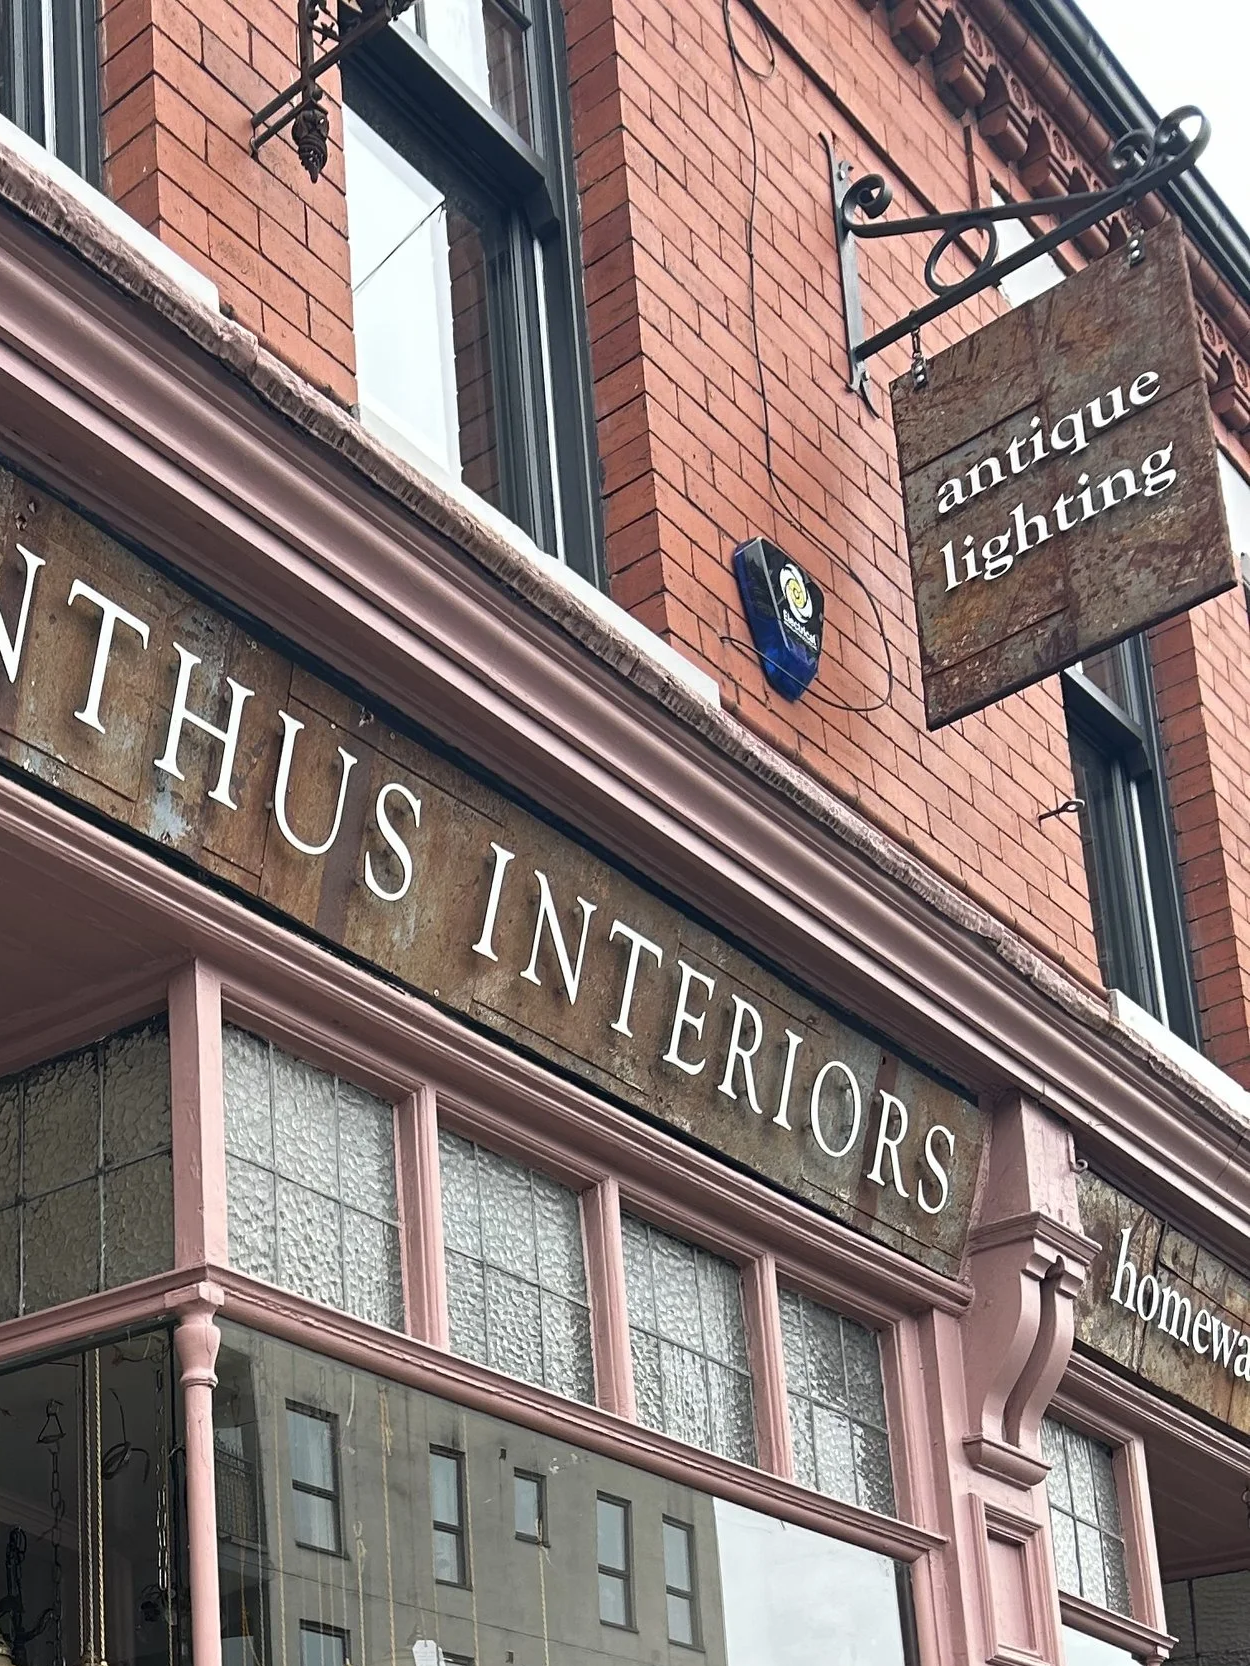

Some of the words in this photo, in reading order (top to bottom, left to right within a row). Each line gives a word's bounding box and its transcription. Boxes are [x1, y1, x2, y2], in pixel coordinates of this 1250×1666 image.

[937, 371, 1162, 513] antique
[939, 441, 1177, 593] lighting
[471, 842, 955, 1214] INTERIORS
[1110, 1227, 1250, 1382] homewa
